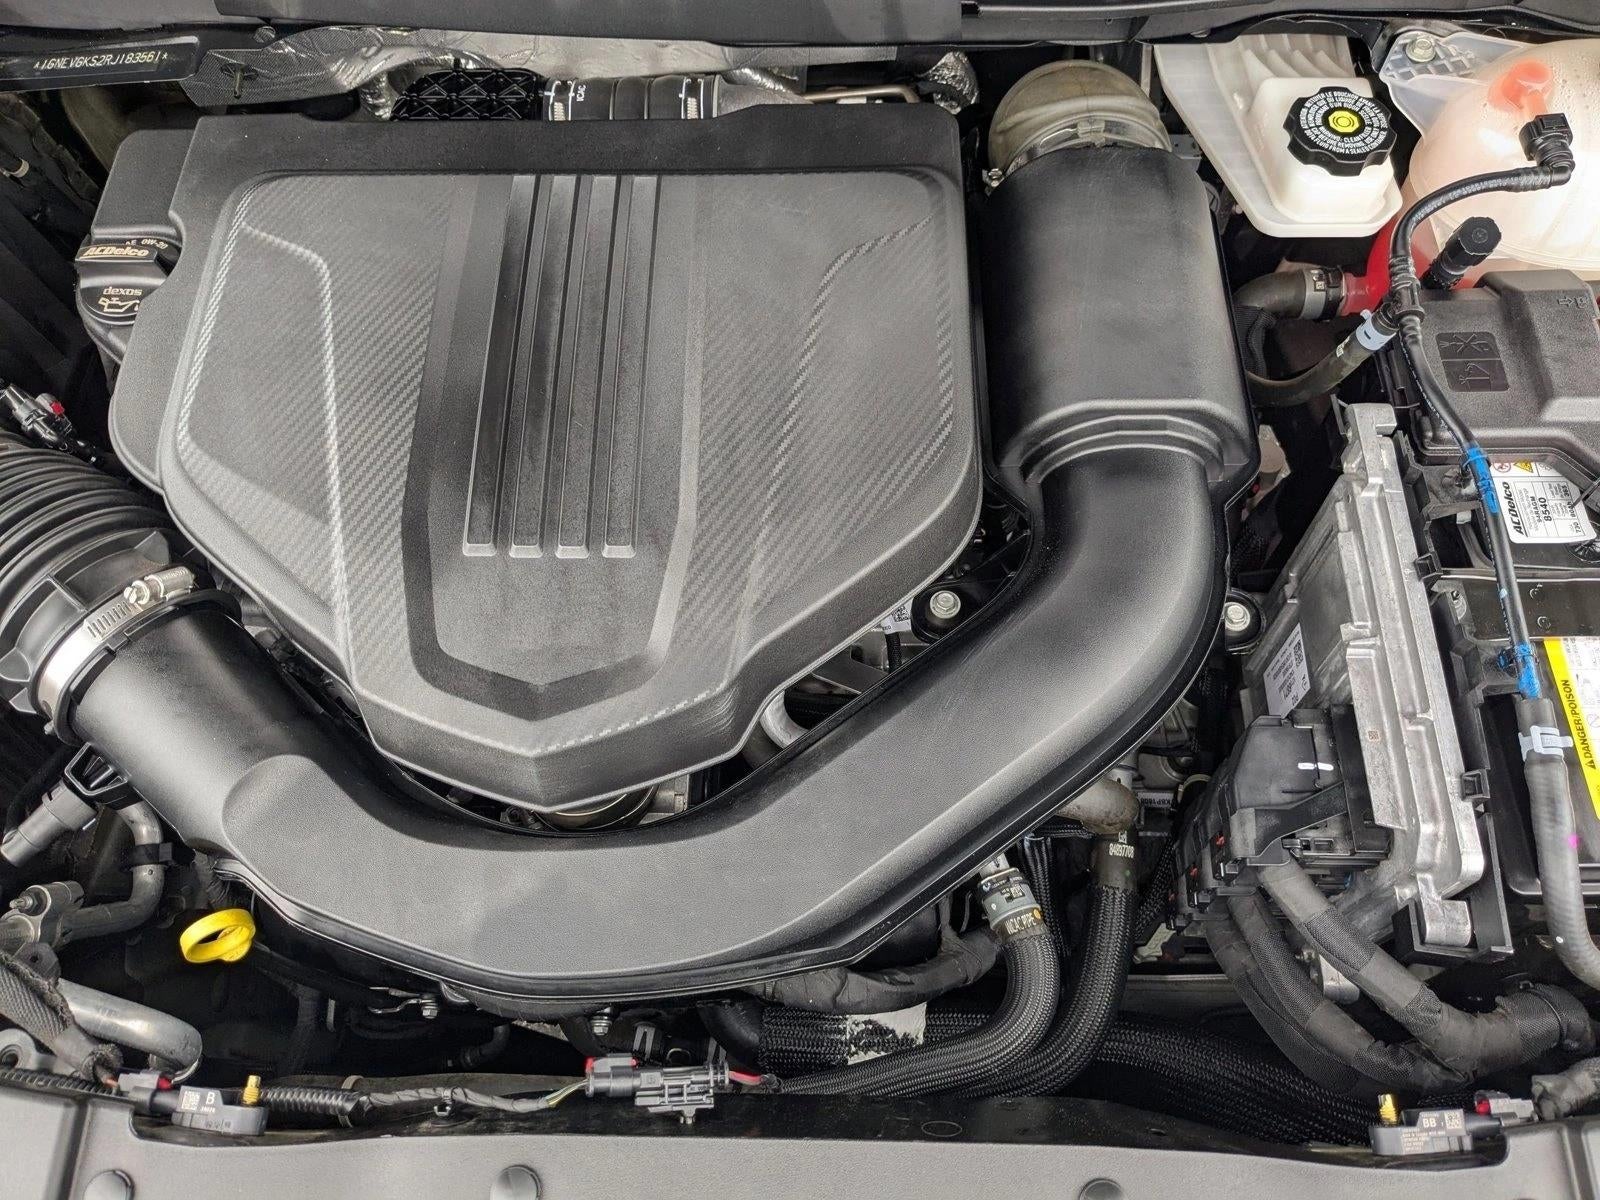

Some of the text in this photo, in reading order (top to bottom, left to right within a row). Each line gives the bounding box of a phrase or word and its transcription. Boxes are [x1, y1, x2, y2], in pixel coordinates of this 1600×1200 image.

[141, 238, 168, 250] 0W-20
[83, 245, 150, 257] ACDelco
[103, 286, 143, 296] dexos
[1502, 481, 1525, 536] ACDelco
[1539, 497, 1553, 522] 8540
[1561, 680, 1593, 759] DANGER/POISON
[206, 1091, 215, 1105] B
[1422, 1117, 1437, 1128] BB
